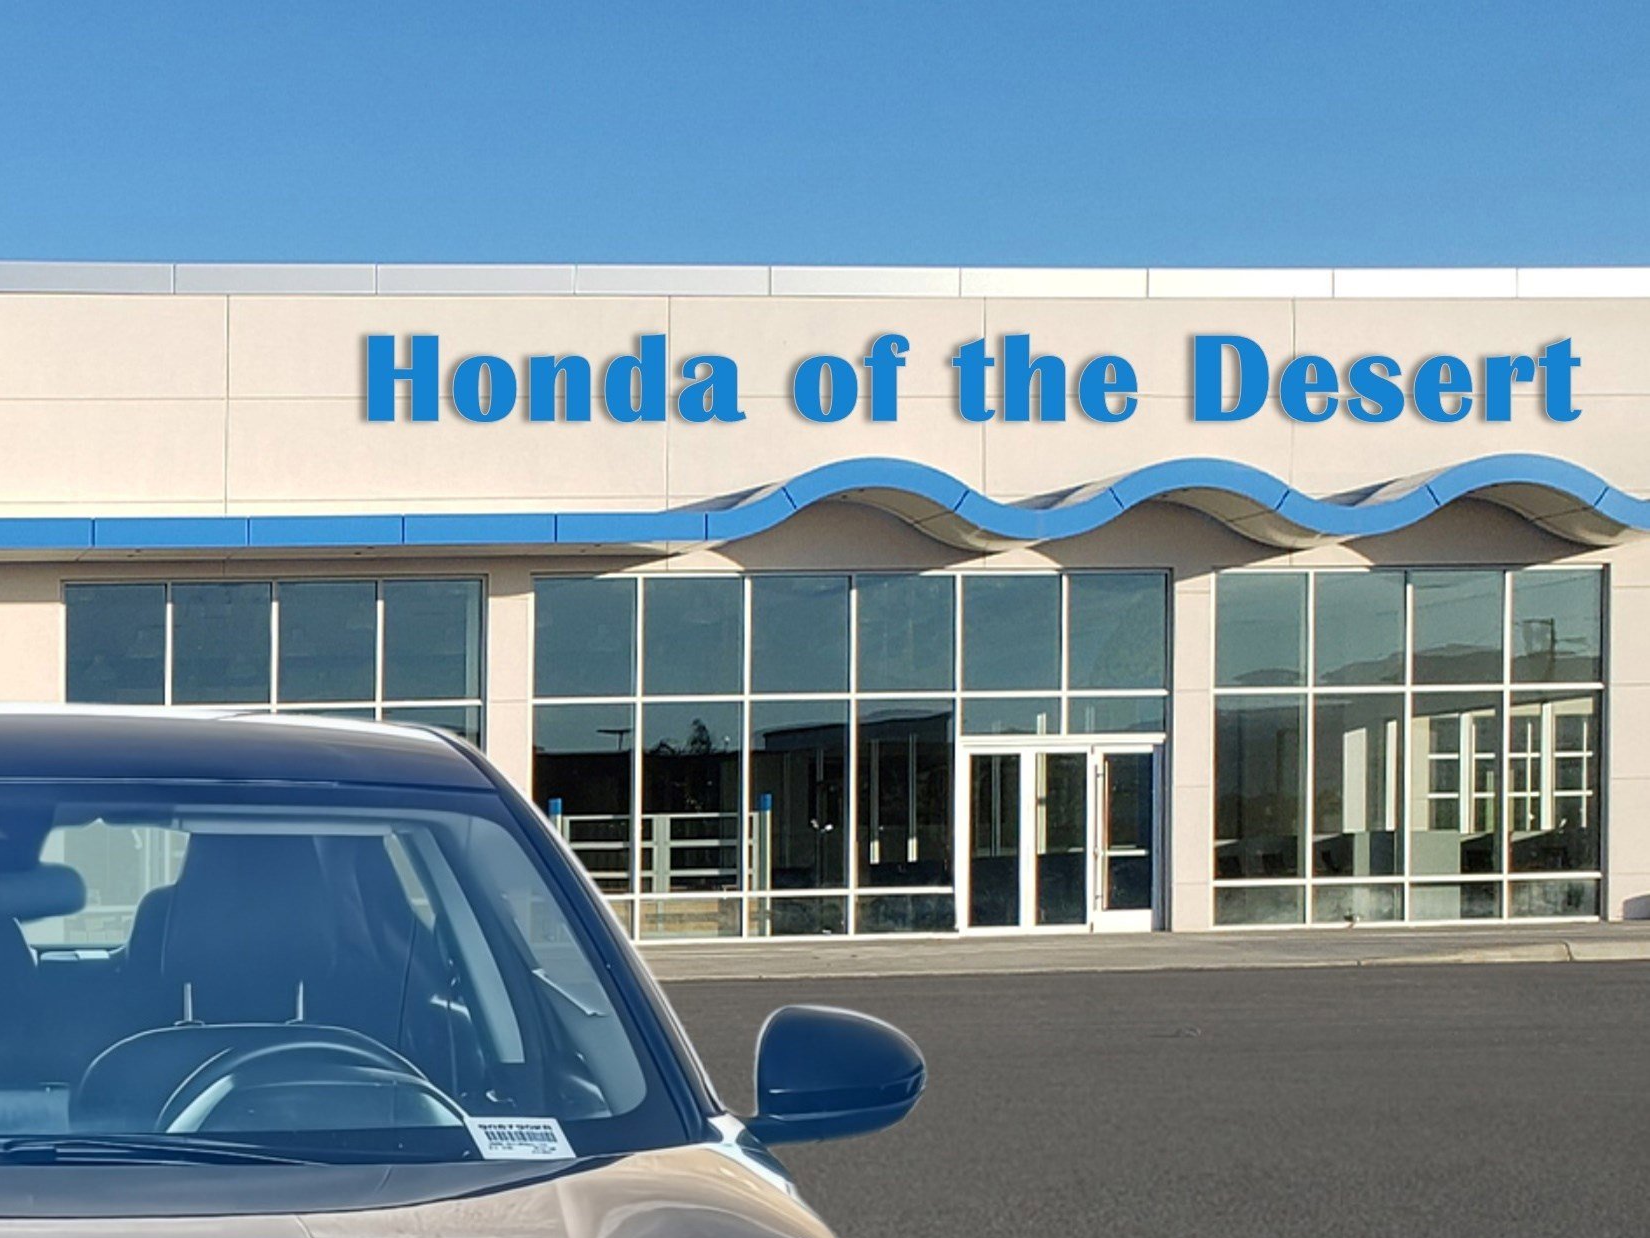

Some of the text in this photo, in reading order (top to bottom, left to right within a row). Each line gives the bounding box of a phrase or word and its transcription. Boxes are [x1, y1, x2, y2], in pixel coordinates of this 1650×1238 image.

[366, 333, 1582, 424] Honda of the Desert
